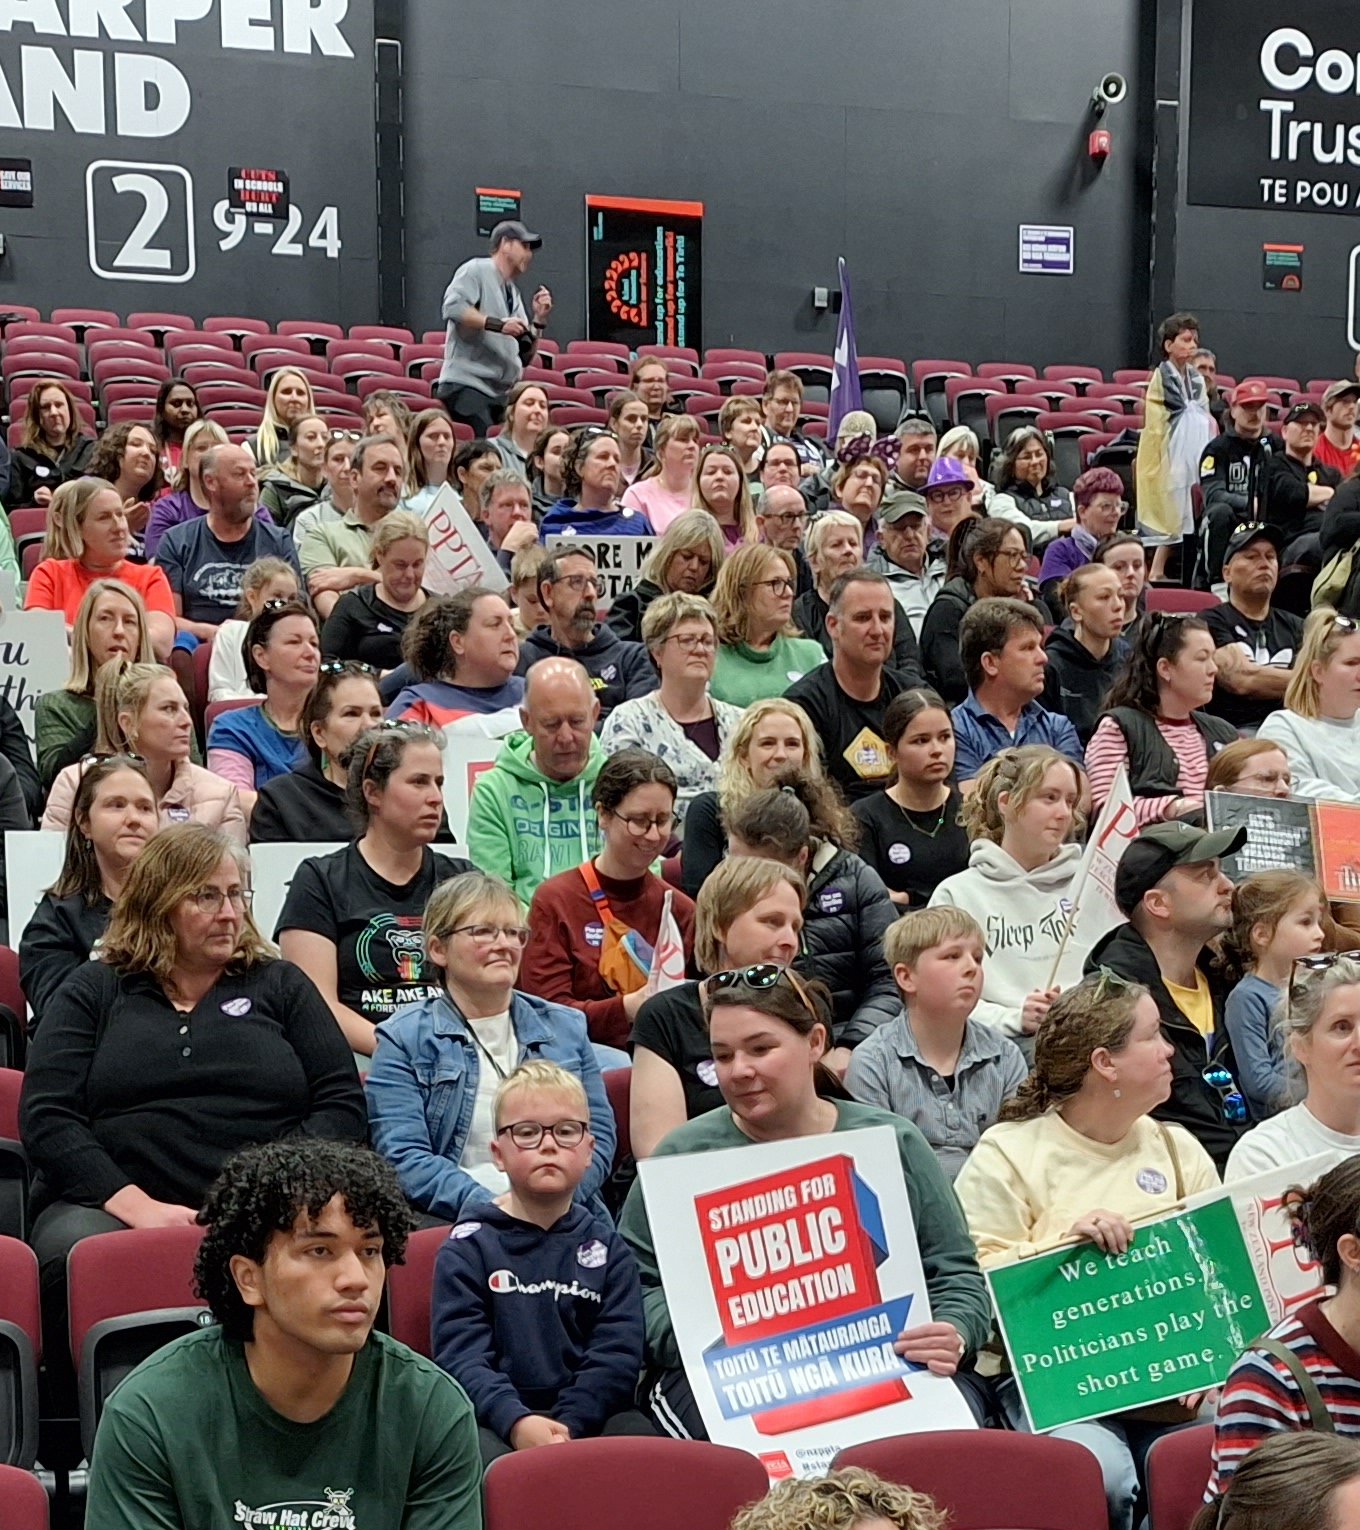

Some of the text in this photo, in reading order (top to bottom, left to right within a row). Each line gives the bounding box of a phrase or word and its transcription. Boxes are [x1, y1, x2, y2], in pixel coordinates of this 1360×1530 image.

[112, 172, 172, 270] 2
[1260, 179, 1287, 204] TE
[1295, 180, 1348, 207] POU
[213, 199, 342, 258] 9-24
[655, 226, 664, 319] up for education
[676, 280, 685, 297] for
[361, 986, 423, 1004] AKE AKE
[708, 1172, 836, 1232] STANDING FOR
[714, 1206, 847, 1288] PUBLIC
[1058, 1236, 1172, 1282] We teach
[489, 1269, 602, 1304] Champion
[728, 1262, 856, 1330] EDUCATION
[1052, 1269, 1204, 1330] generations.
[713, 1352, 758, 1379] TOITŪ
[760, 1344, 781, 1367] TE
[1022, 1292, 1254, 1374] Politicians play the
[723, 1342, 902, 1414] TOITŪ NGĀ KURA
[1076, 1347, 1224, 1397] short game.
[234, 1499, 278, 1525] Straw
[279, 1509, 309, 1526] Hat
